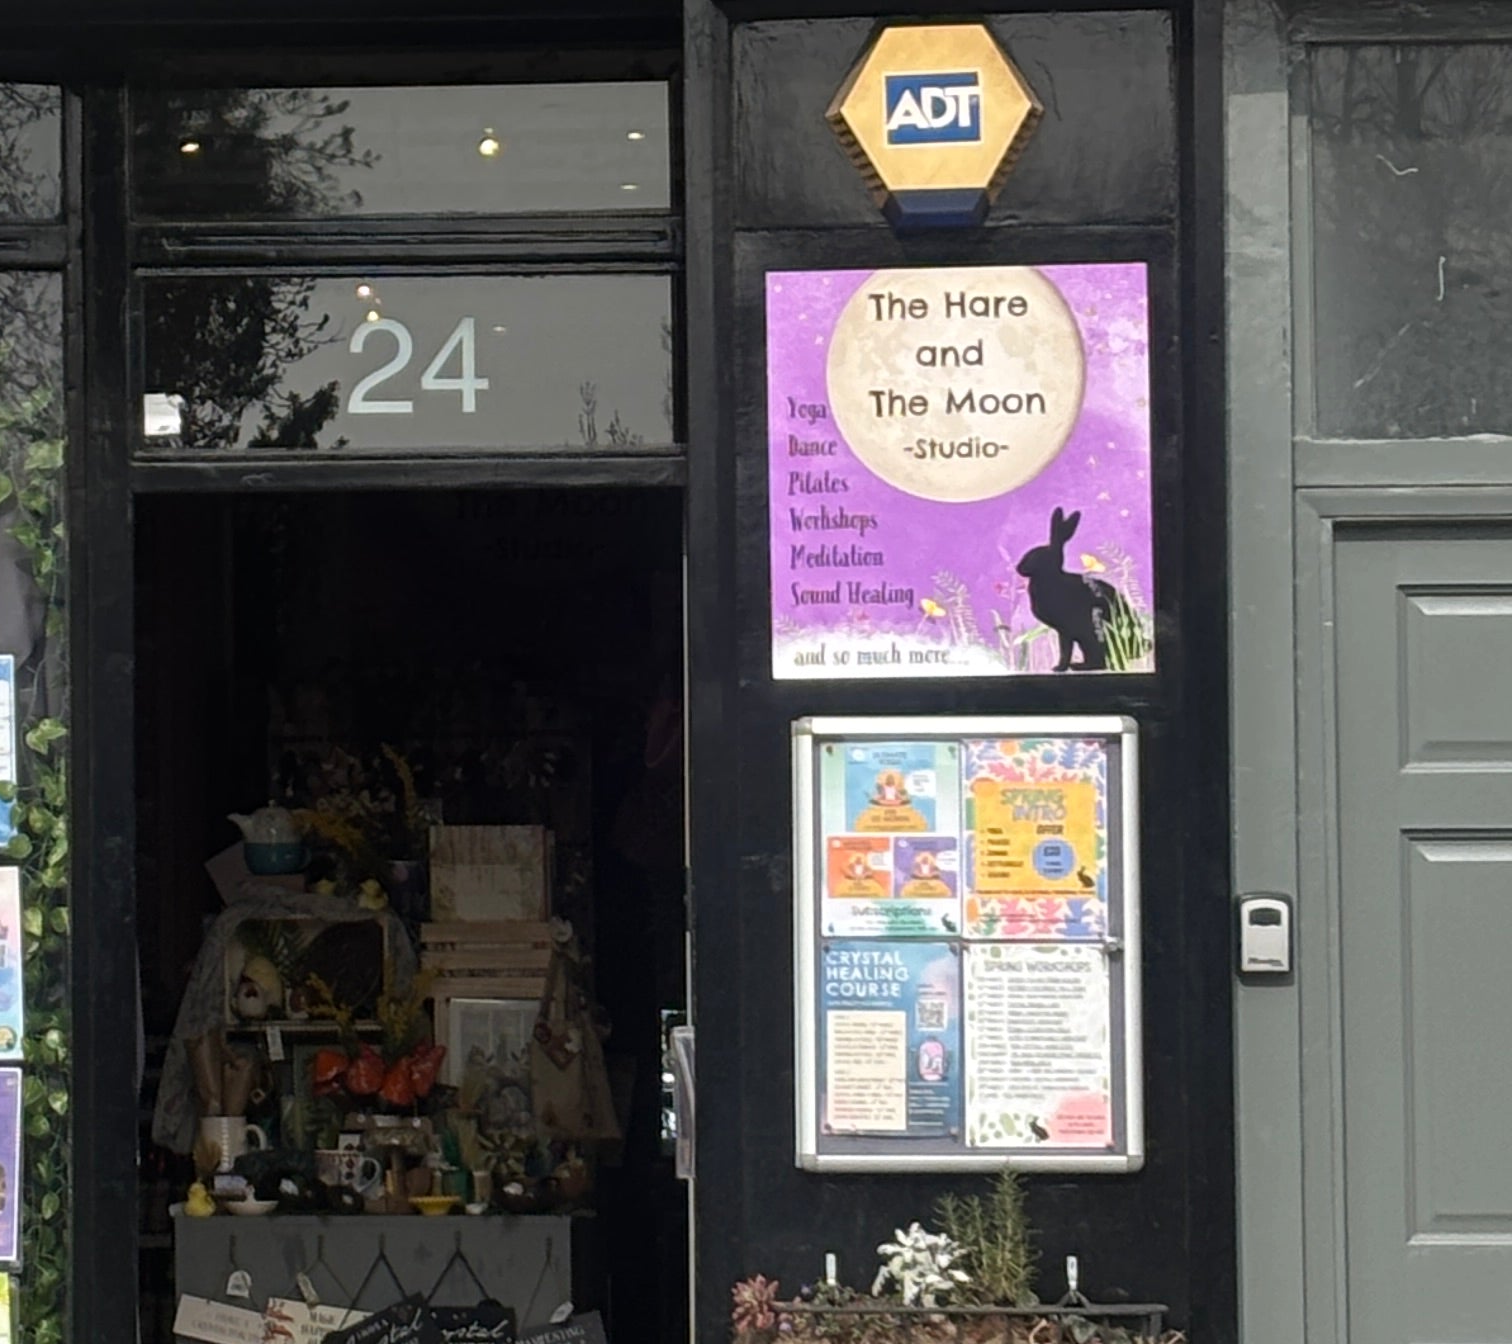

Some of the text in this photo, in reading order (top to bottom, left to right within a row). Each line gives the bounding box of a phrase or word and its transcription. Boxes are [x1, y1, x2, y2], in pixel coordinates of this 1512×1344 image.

[887, 86, 979, 131] ADT
[868, 290, 1029, 322] The Hare
[347, 317, 490, 414] 24
[915, 338, 984, 368] and
[787, 396, 827, 426] Yoga
[868, 386, 1047, 418] The Moon
[788, 434, 838, 458] Dance
[902, 436, 1010, 460] -Studio-
[787, 469, 850, 496] Pilates
[790, 504, 879, 538] Workshops
[790, 543, 885, 571] Meditation
[790, 580, 915, 610] Sound Healing
[794, 642, 827, 667] and
[833, 650, 851, 666] so
[857, 641, 902, 666] much
[826, 950, 904, 966] CRYSTAL
[825, 966, 910, 982] HEALING
[825, 982, 903, 998] COURSE
